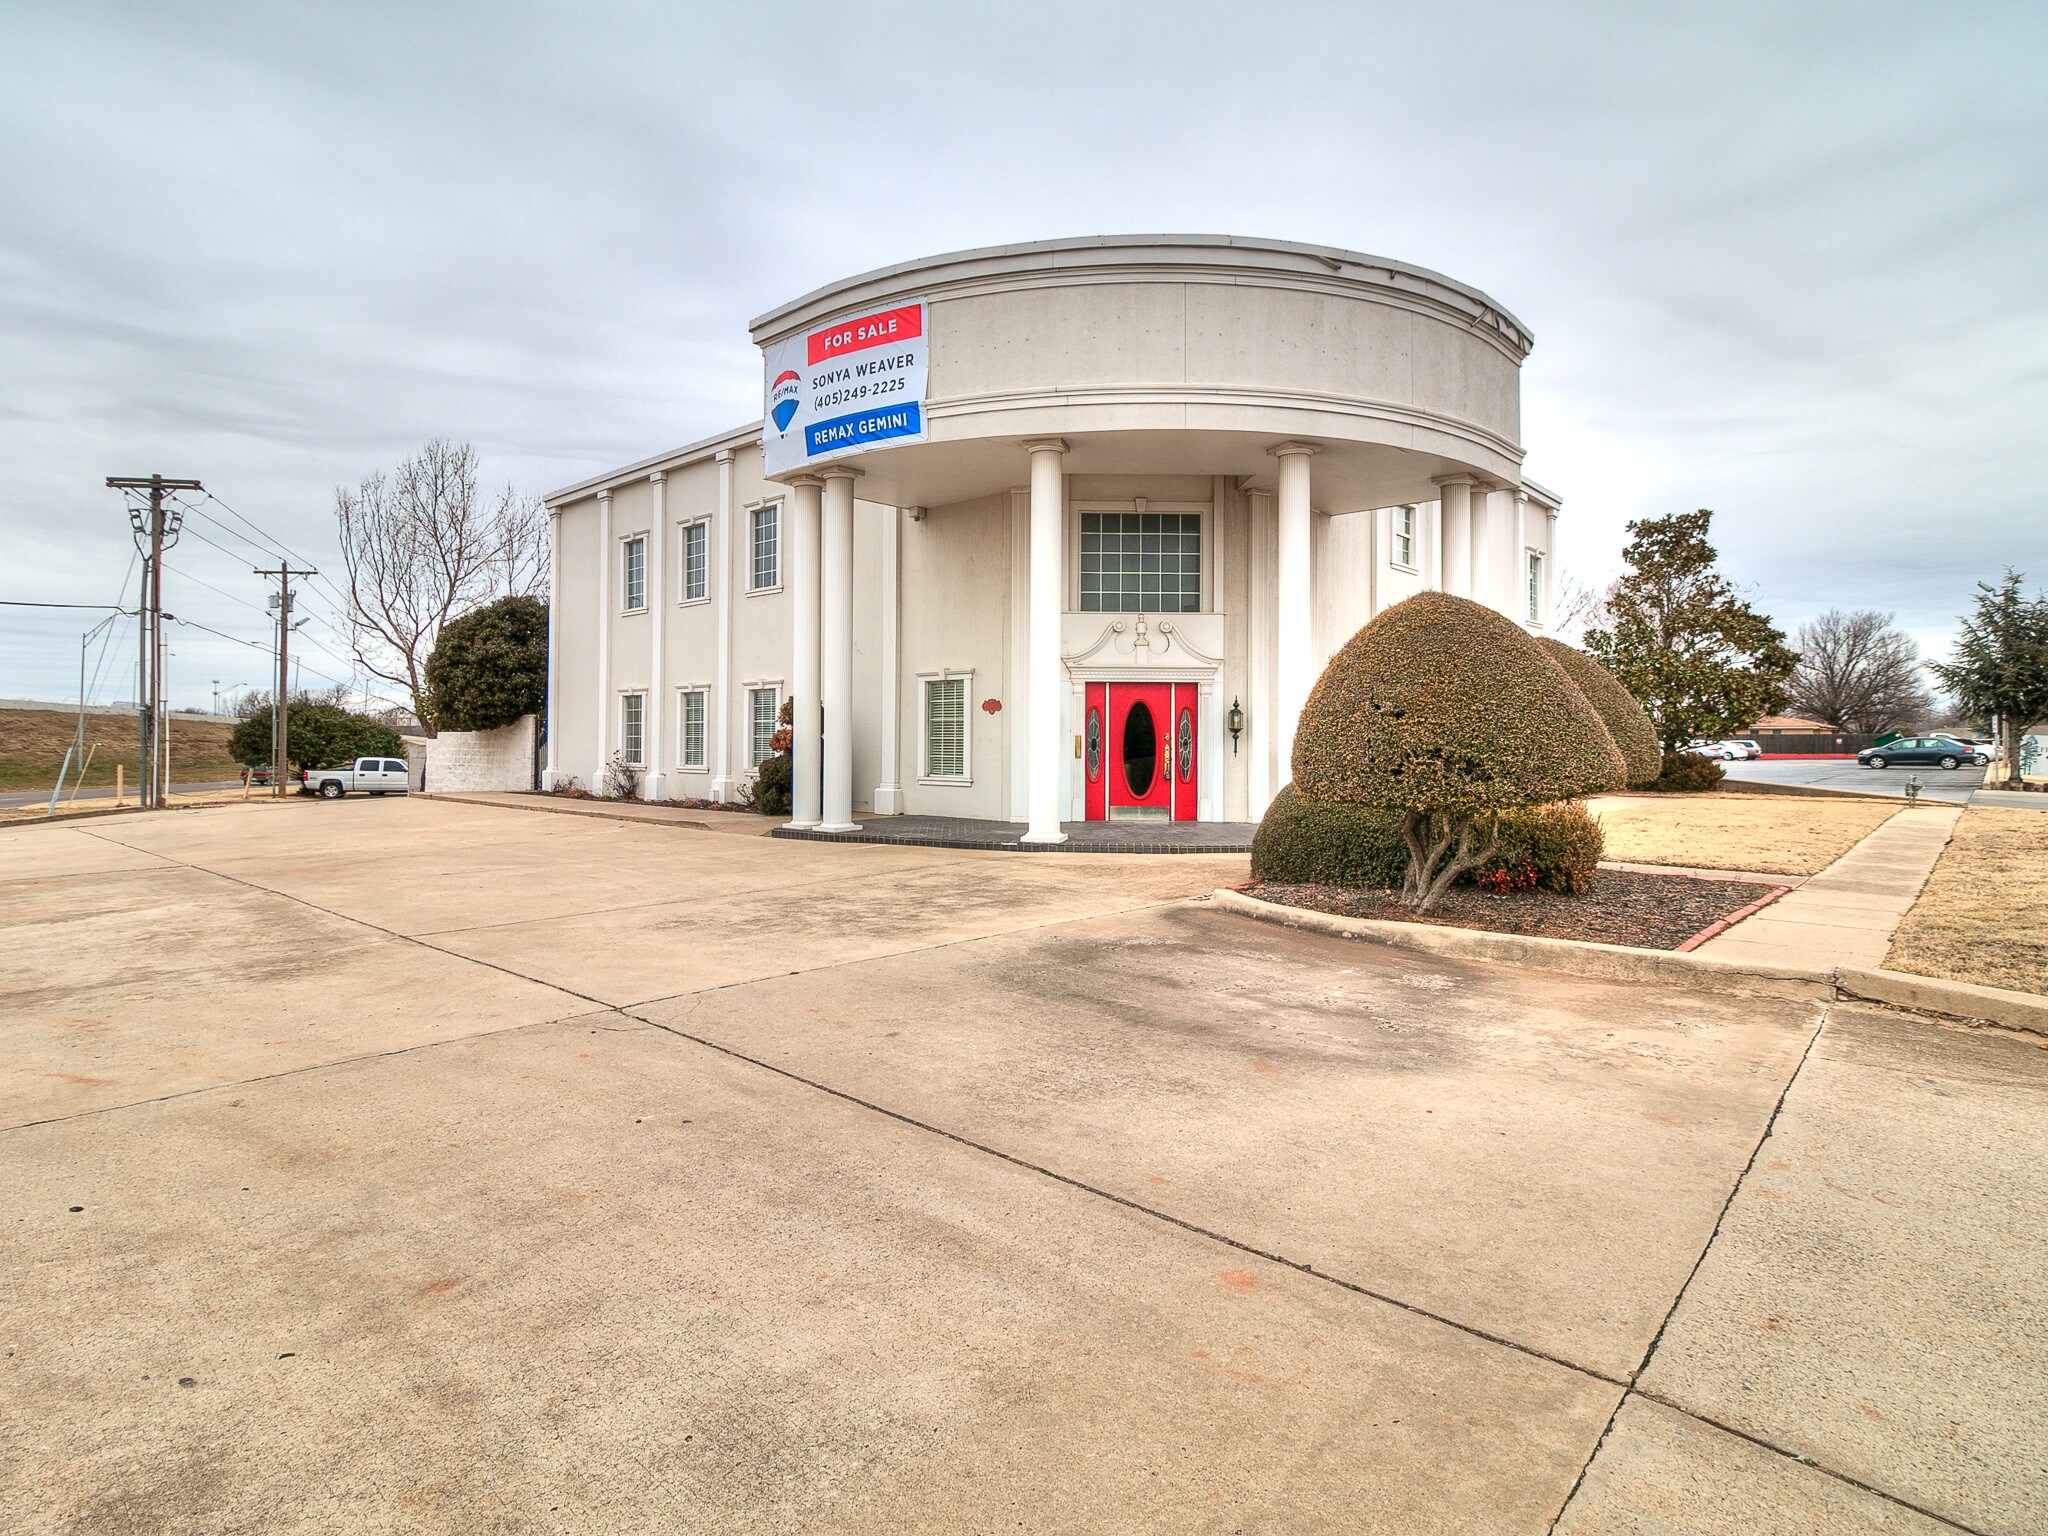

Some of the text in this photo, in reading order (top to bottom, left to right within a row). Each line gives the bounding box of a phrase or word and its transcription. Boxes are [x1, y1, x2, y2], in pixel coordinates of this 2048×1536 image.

[824, 319, 898, 351] FOR SALE
[812, 353, 915, 390] SONYA WEAVER
[773, 385, 799, 403] RE/MAX
[814, 377, 905, 411] (405)249-2225
[814, 412, 908, 445] REMAX GEMINI
